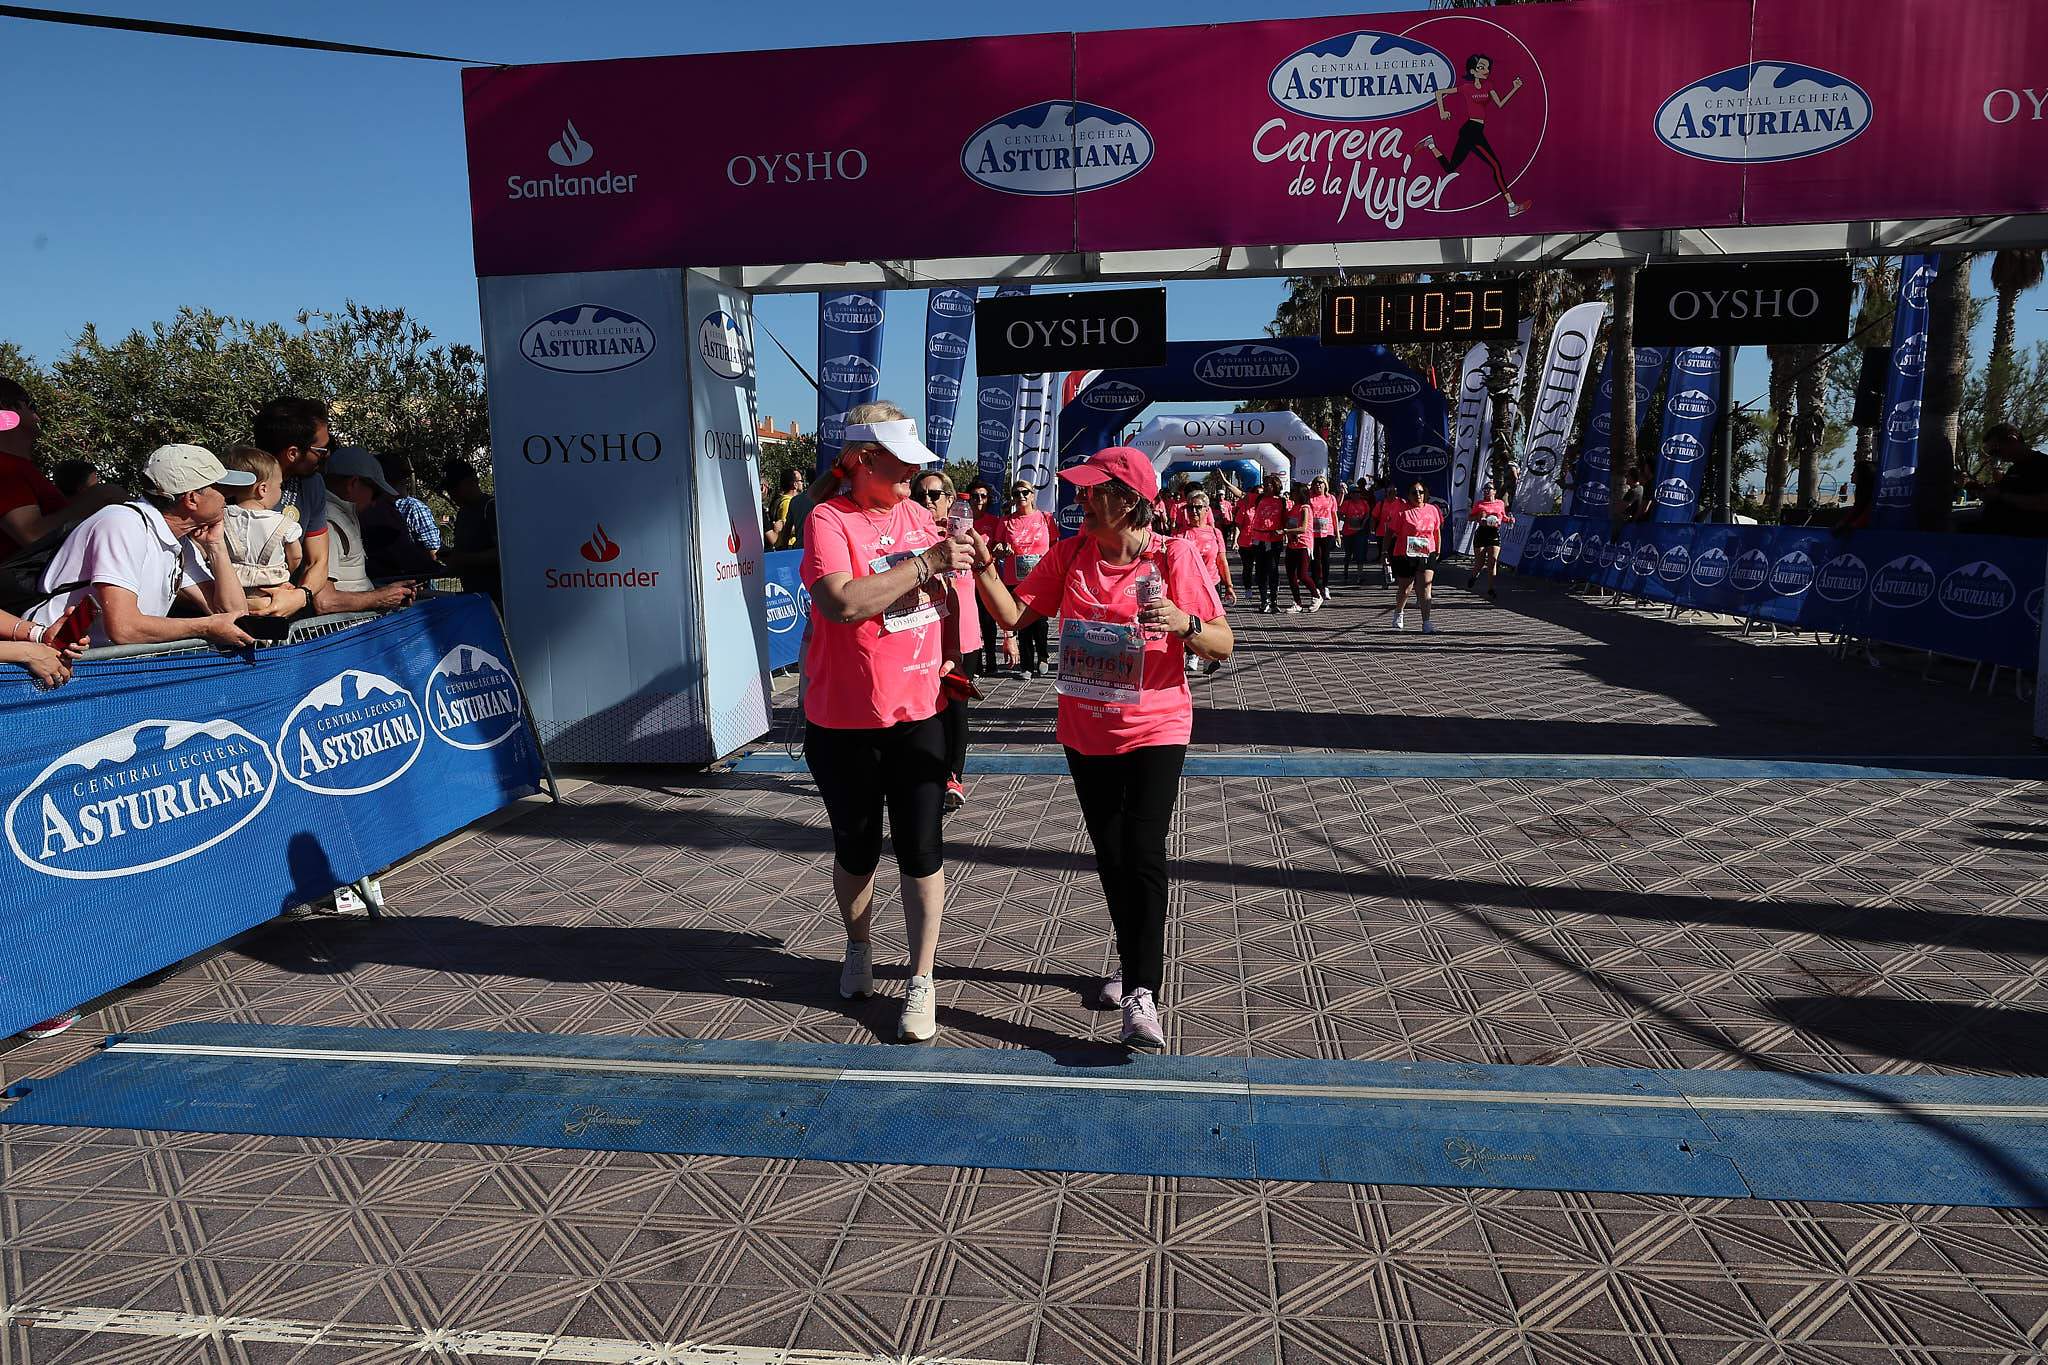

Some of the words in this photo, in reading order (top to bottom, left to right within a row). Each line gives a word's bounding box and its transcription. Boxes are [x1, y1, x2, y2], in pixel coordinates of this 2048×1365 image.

[1283, 66, 1440, 100] ASTURIANA
[1312, 62, 1369, 73] CENTRAL
[1375, 59, 1435, 70] LECHERA
[1705, 97, 1771, 109] CENTRAL
[1778, 92, 1849, 106] LECHERA
[1670, 102, 1854, 140] ASTURIANA
[975, 139, 1140, 174] ASTURIANA
[1004, 133, 1065, 146] CENTRAL
[1253, 118, 1403, 164] Carrera
[727, 149, 868, 186] OYSHO
[1288, 170, 1315, 198] de
[1321, 163, 1342, 197] la
[507, 170, 637, 200] Santander
[1338, 154, 1460, 229] Mujer
[1668, 287, 1820, 321] OYSHO
[530, 332, 647, 358] ASTURIANA
[1006, 315, 1139, 349] OYSHO
[1201, 359, 1292, 380] ASTURIANA
[1086, 388, 1140, 401] ASTURIANA
[1354, 381, 1417, 398] ASTURIANA
[1527, 330, 1588, 477] OYSHO
[1183, 418, 1265, 438] OYSHO
[522, 431, 663, 465] OYSHO
[704, 429, 753, 462] OYSHO
[546, 567, 659, 589] Santander
[715, 559, 755, 581] Santander
[766, 604, 796, 623] STURIANA
[446, 679, 477, 696] CENTRAL
[477, 673, 506, 688] LECHER
[316, 710, 363, 732] CENTRAL
[363, 696, 407, 720] LECHERA
[436, 687, 518, 732] ASTURIAN
[299, 712, 420, 779] ASTURIANA
[73, 767, 162, 798] CENTRAL
[168, 742, 249, 773] LECHERA
[39, 760, 265, 860] ASTURIANA
